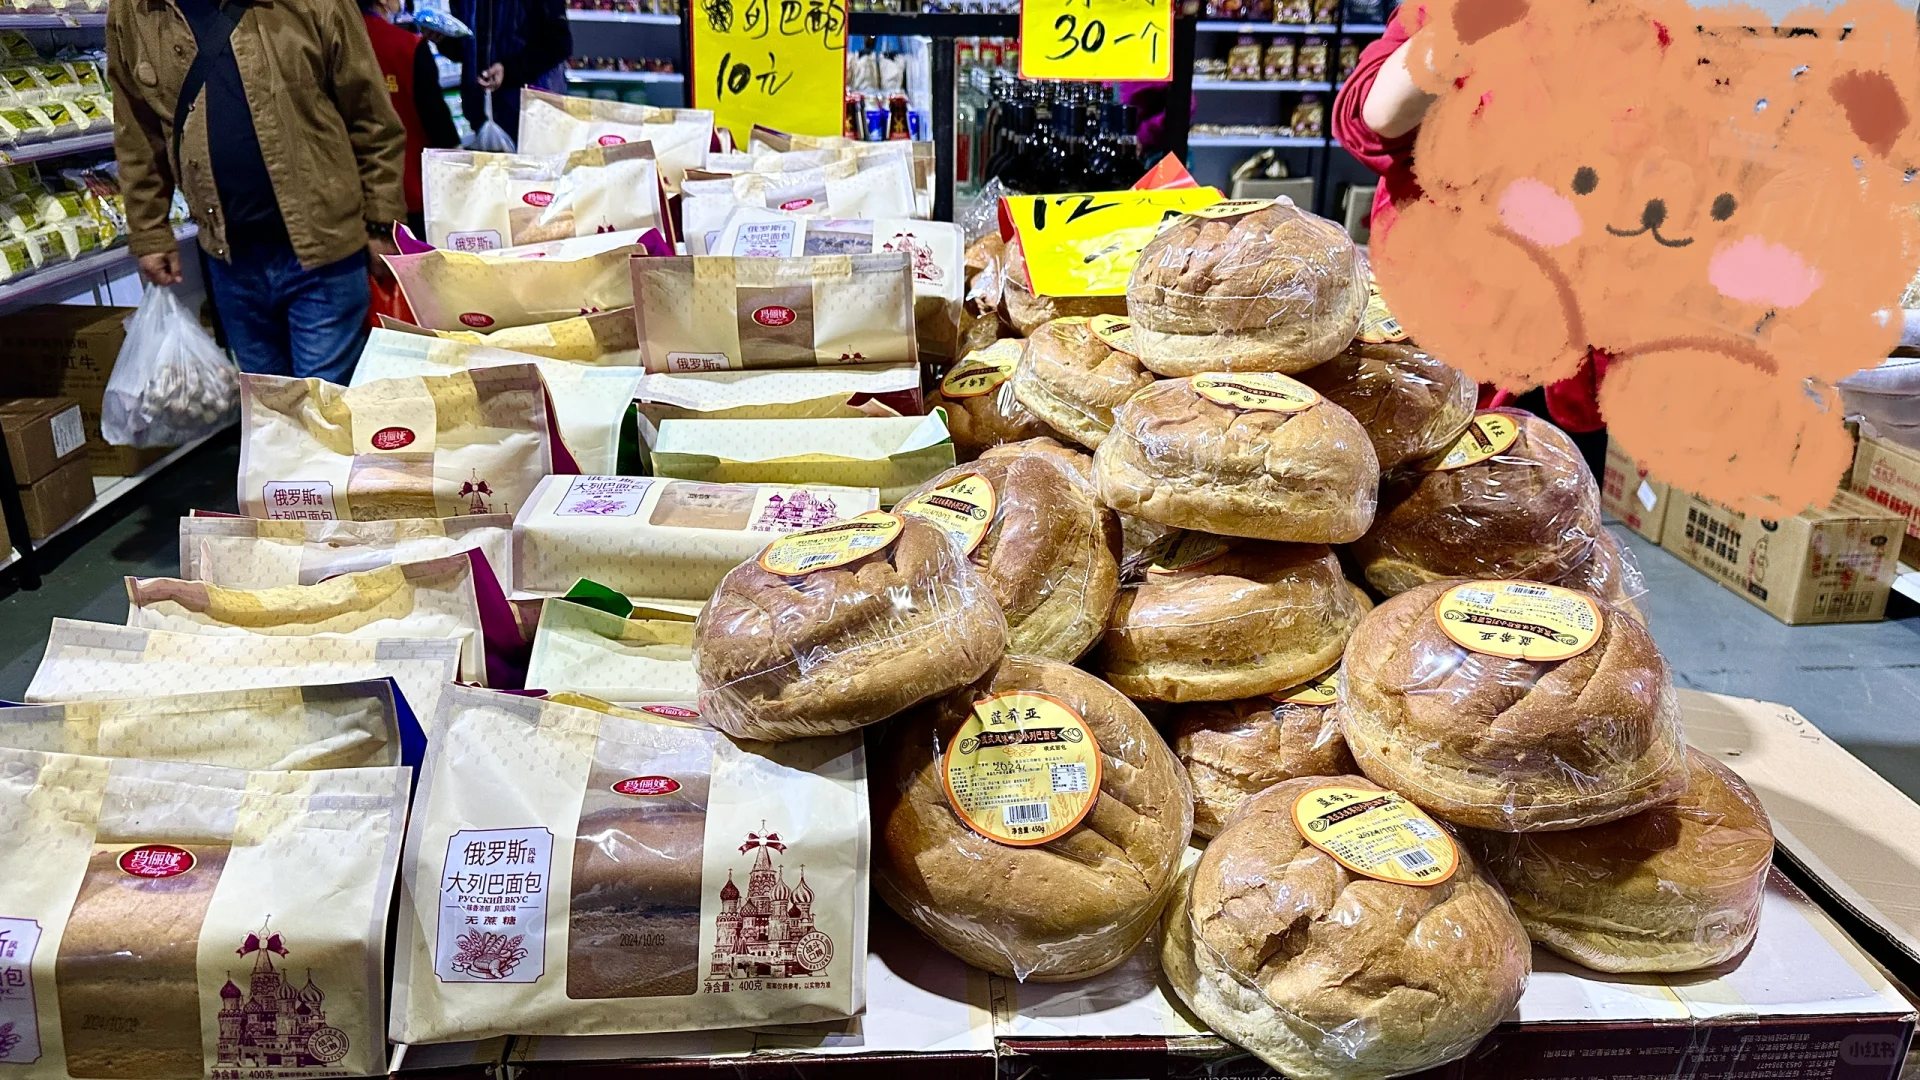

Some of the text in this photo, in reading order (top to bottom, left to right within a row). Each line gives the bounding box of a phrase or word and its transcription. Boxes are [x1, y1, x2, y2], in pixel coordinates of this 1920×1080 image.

[715, 52, 793, 102] 10元
[455, 236, 487, 250] 俄罗斯
[677, 357, 716, 370] 俄罗斯
[573, 482, 644, 490] 大列巴面包
[273, 488, 316, 507] 俄罗斯
[1479, 631, 1535, 646] 蓝希亚
[990, 708, 1041, 726] 蓝希亚
[625, 780, 668, 789] 玛俪娅
[132, 850, 181, 867] 玛俪娅
[464, 839, 536, 866] 俄罗斯 风味
[446, 871, 542, 895] 大列巴面包
[458, 895, 529, 904] РУССКИЙ ВКУС
[465, 915, 517, 925] 无蔗糖
[620, 933, 665, 946] 2024/10/03
[8, 941, 18, 958] 风味
[0, 966, 26, 988] 包
